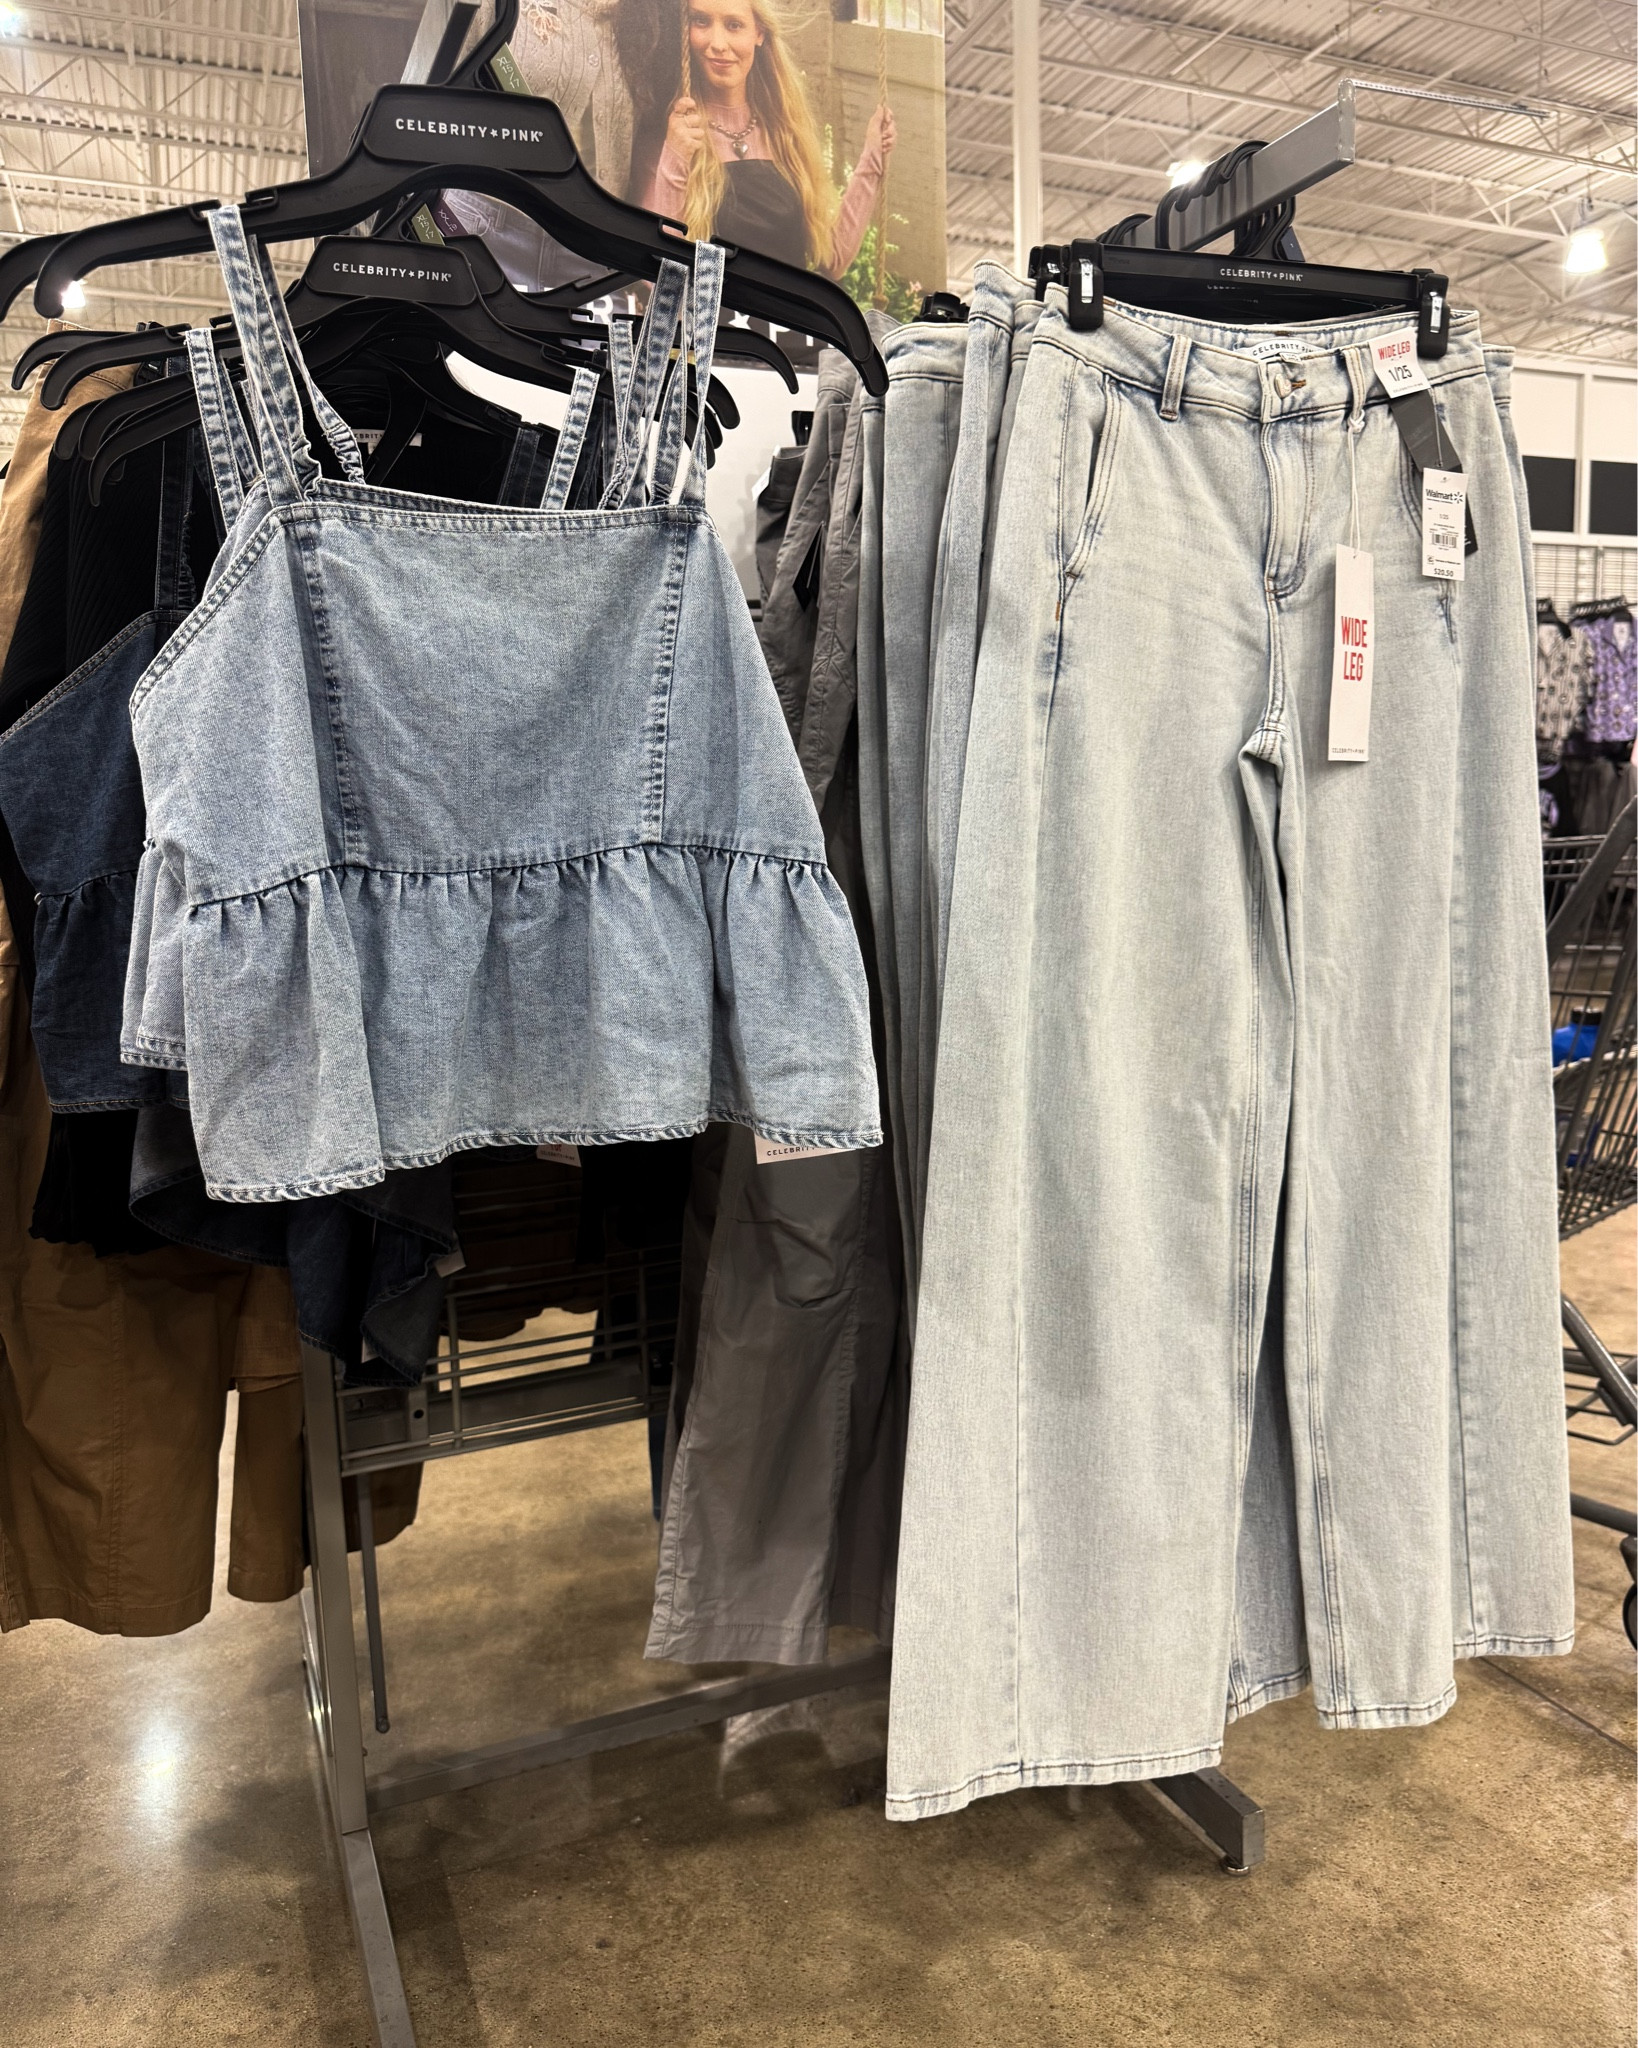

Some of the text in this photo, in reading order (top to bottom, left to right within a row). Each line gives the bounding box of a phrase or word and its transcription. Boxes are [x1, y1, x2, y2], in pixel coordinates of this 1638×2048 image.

[496, 57, 511, 66] XL
[502, 64, 514, 74] 15
[510, 79, 520, 89] 17
[395, 118, 488, 138] CELEBRITY
[333, 262, 407, 278] CELEBRITY
[1220, 268, 1272, 279] CELEBRITY
[1252, 343, 1299, 356] CELEBRITY
[1378, 341, 1411, 360] WIDE LEG
[1388, 365, 1413, 381] 1/25
[1425, 488, 1453, 501] Walmart
[1341, 616, 1368, 648] WIDE
[1343, 651, 1364, 681] LEG
